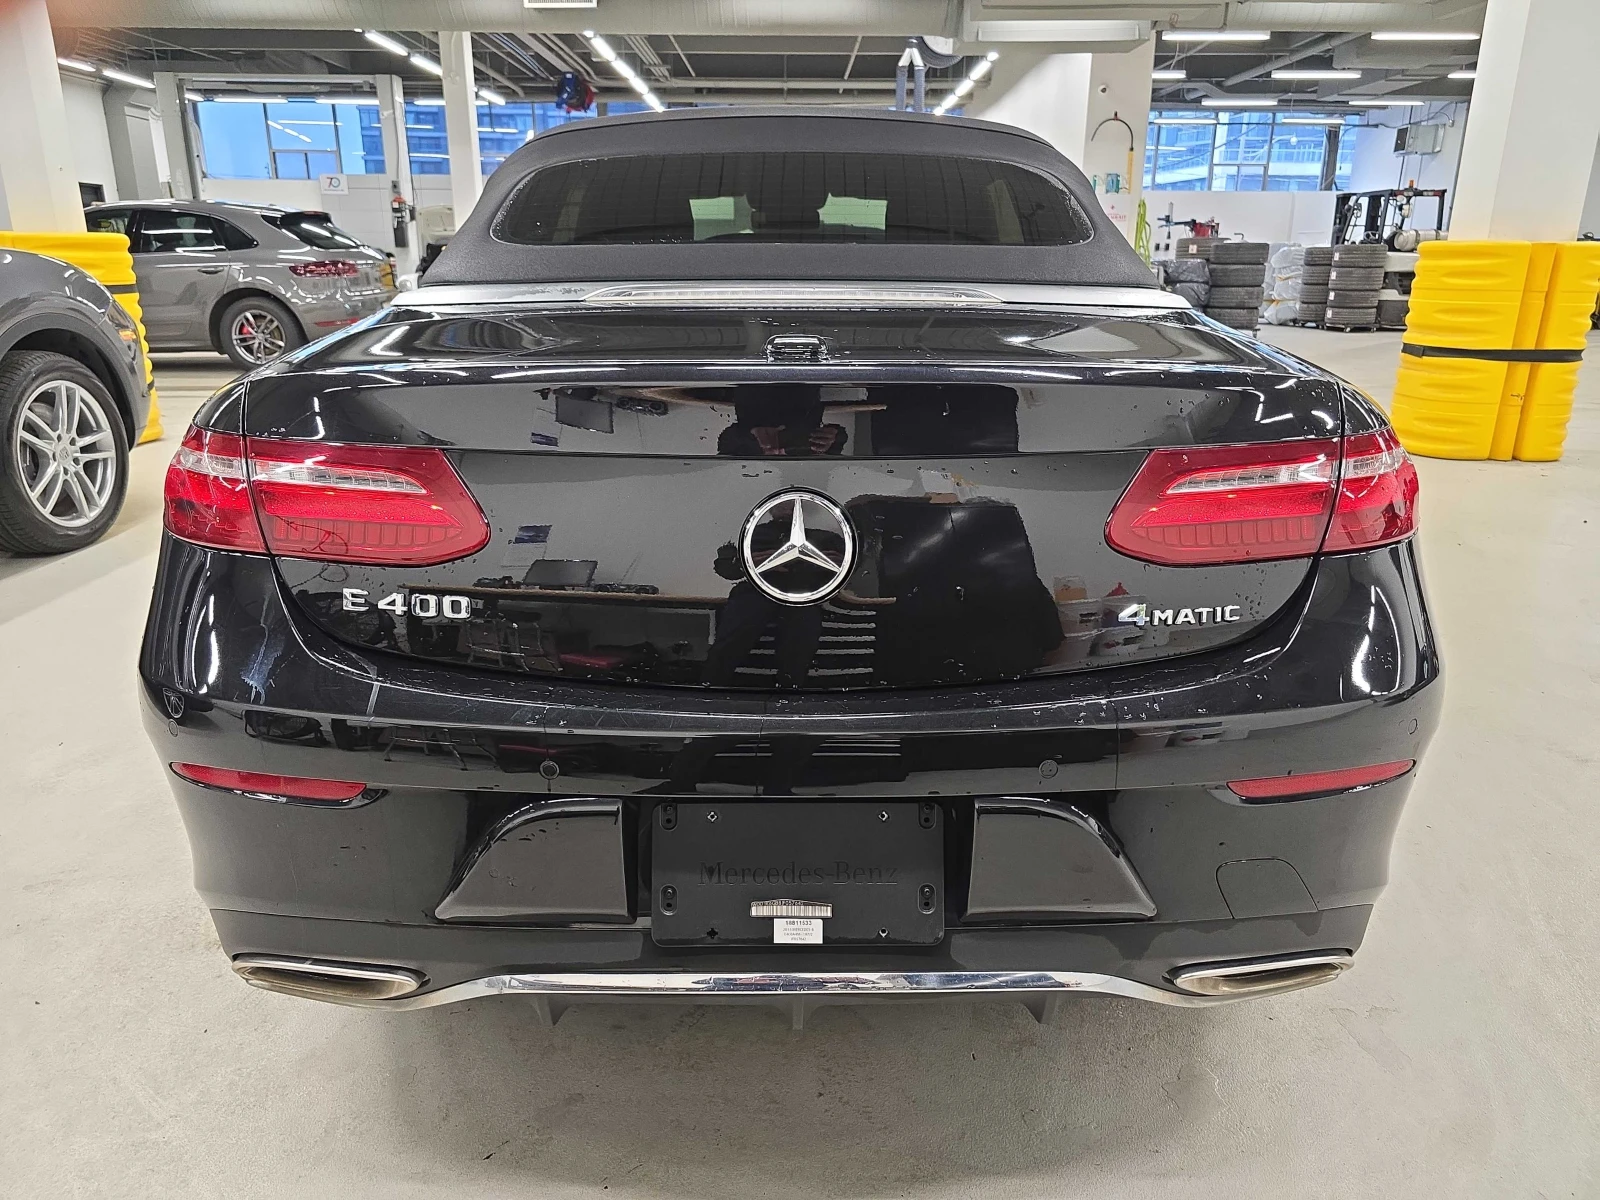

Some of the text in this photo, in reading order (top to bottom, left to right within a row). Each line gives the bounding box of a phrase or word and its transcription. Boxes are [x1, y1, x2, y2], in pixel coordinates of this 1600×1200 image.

[342, 588, 472, 619] E 400
[1117, 603, 1241, 626] 4MATIC
[699, 860, 898, 885] Mercedes-Benz
